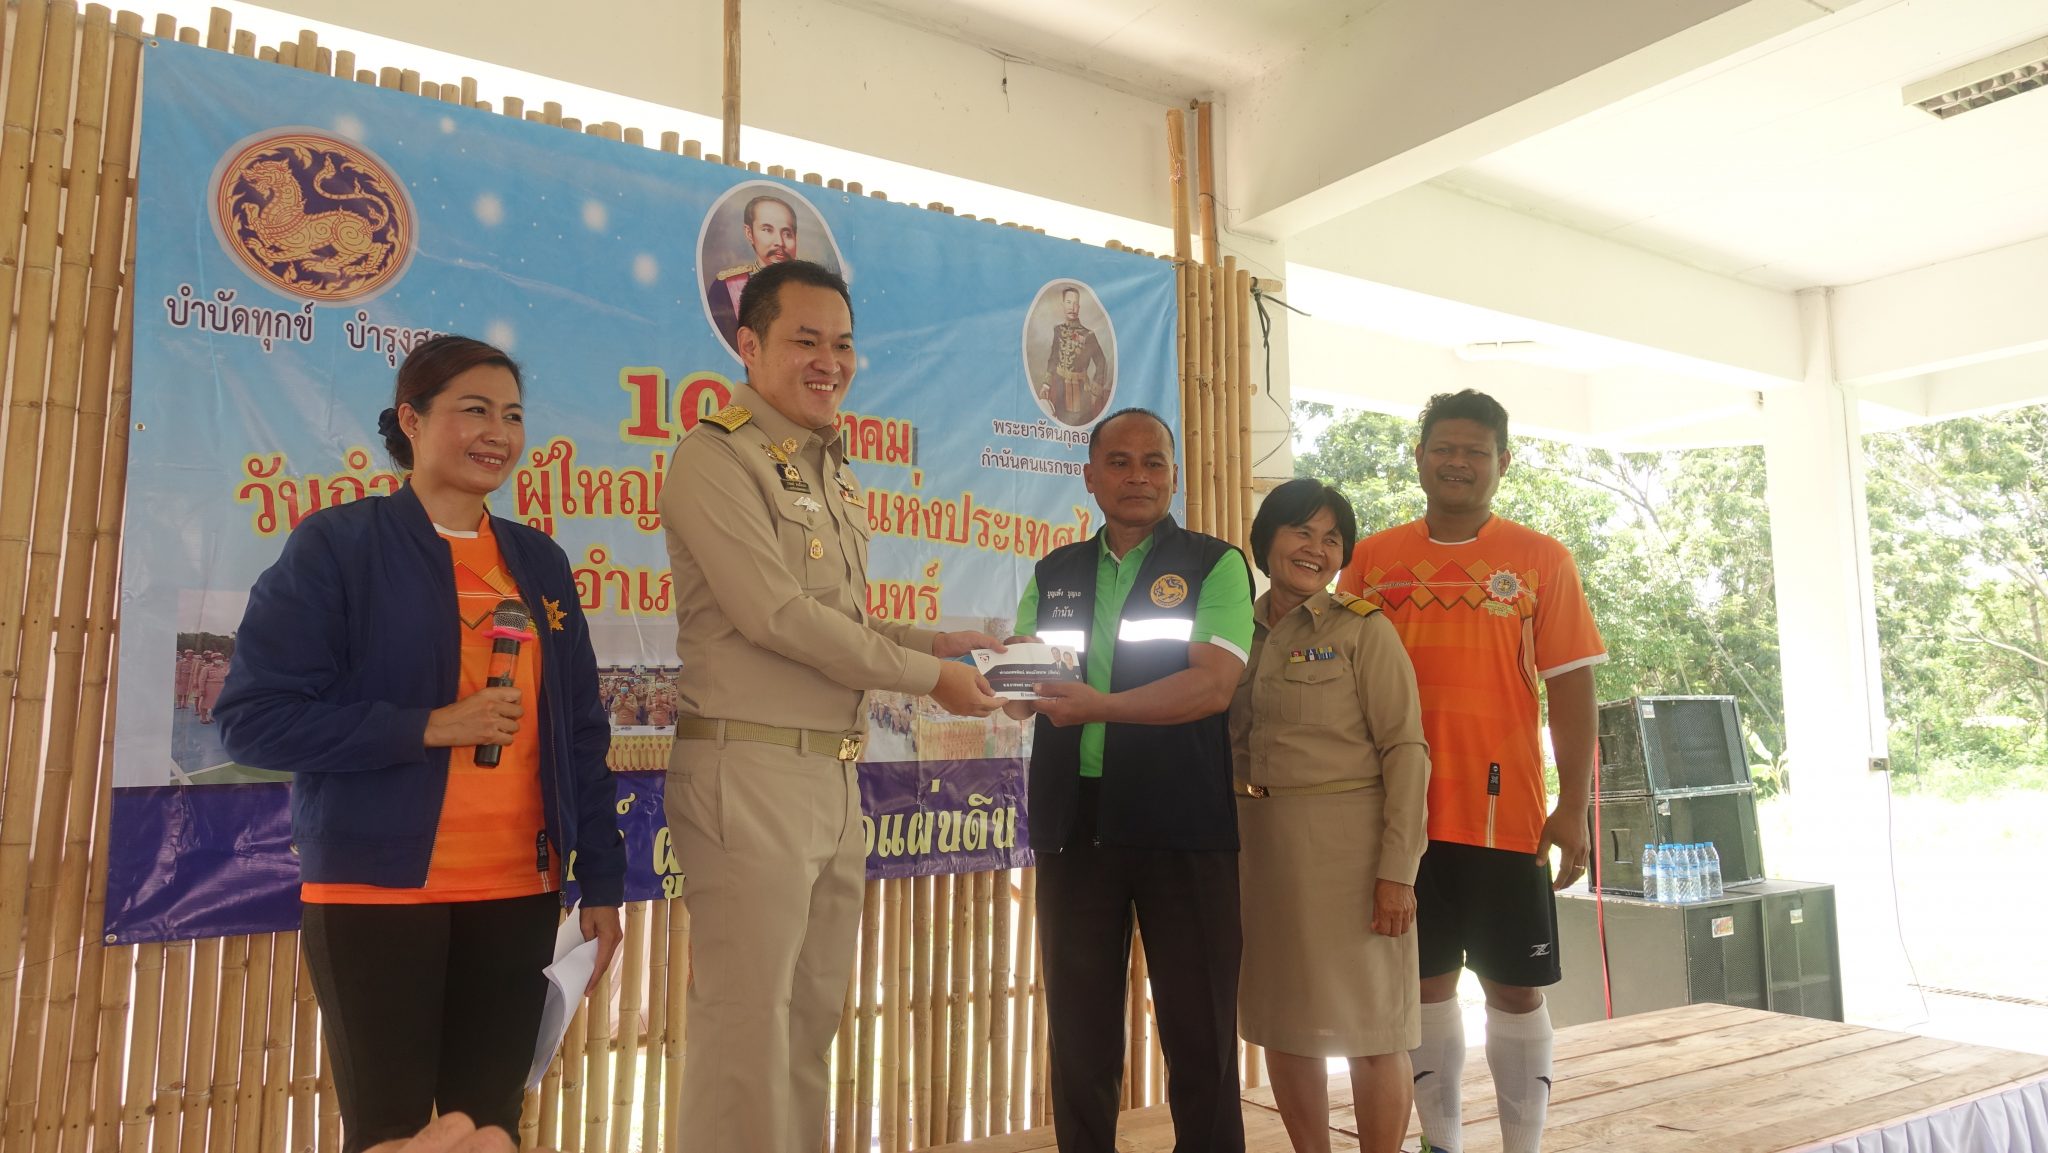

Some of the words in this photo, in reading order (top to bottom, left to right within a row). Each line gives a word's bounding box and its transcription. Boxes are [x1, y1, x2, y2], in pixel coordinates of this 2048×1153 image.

[166, 285, 314, 350] บำบัดทุกข์
[831, 413, 911, 464] าคม
[239, 450, 412, 534] วันกำ
